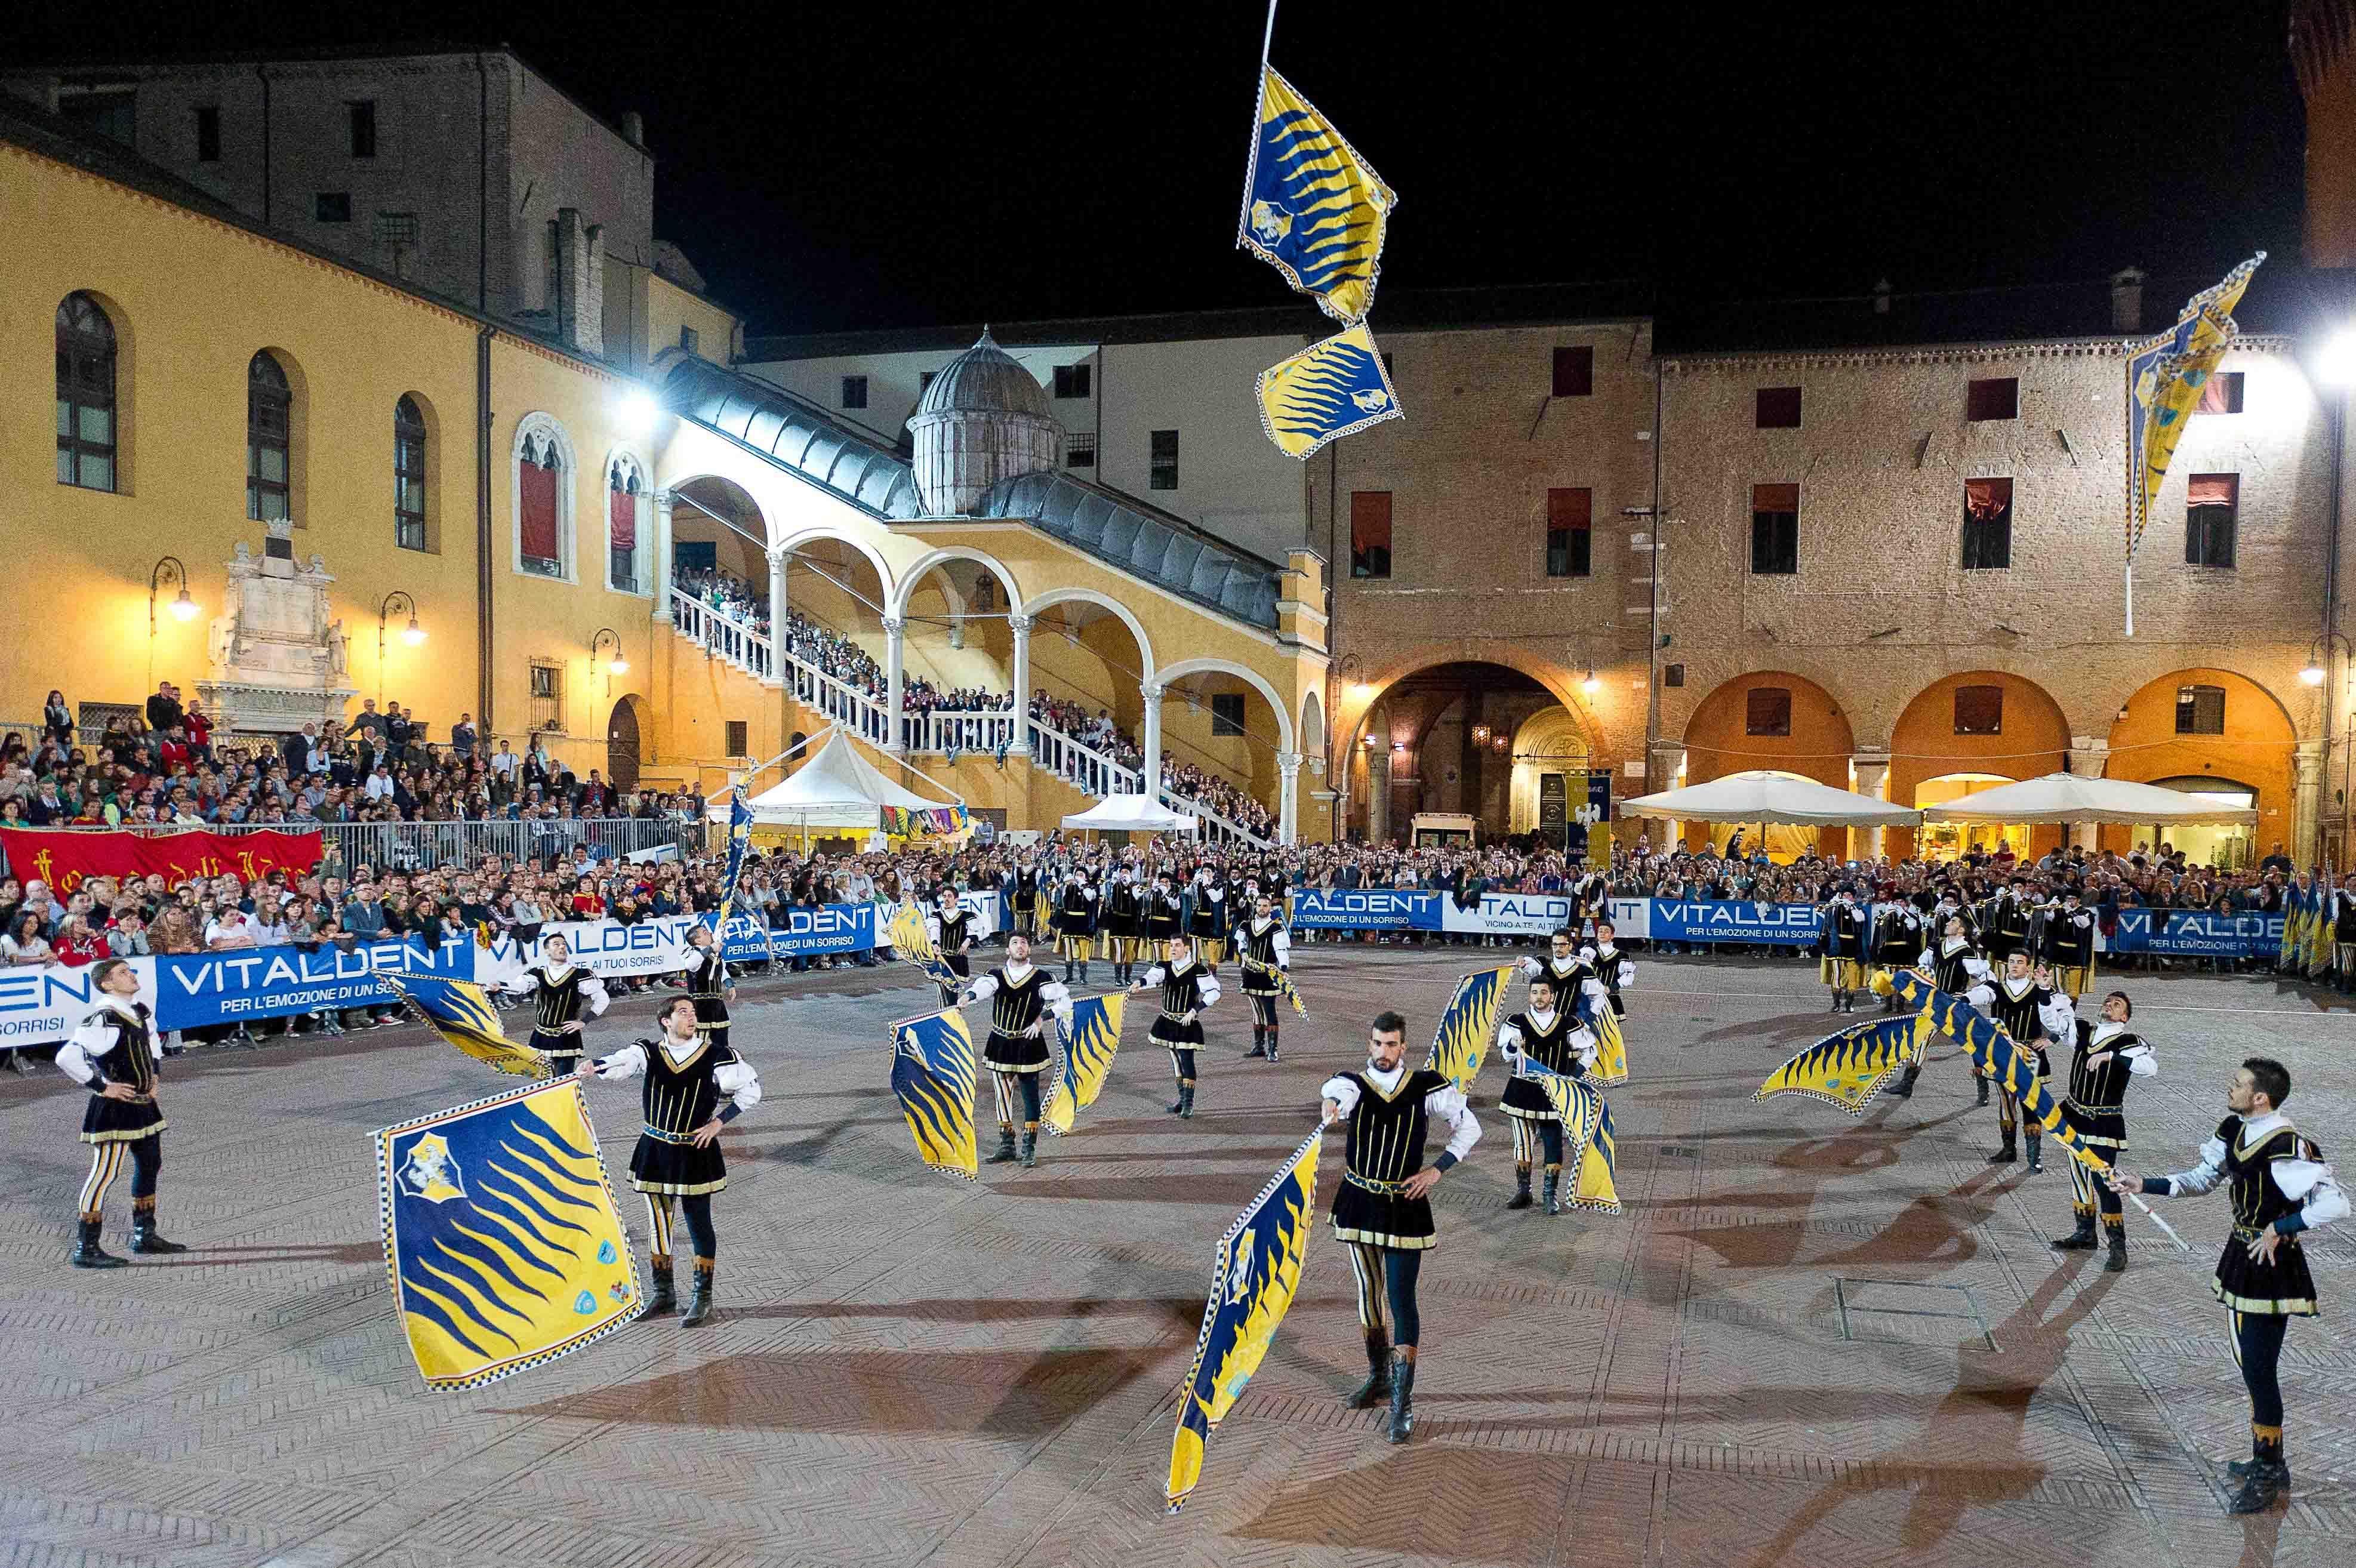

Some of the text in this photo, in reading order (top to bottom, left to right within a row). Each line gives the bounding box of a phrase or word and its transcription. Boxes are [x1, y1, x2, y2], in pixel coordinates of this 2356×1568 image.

[1299, 914, 1347, 923] L'EMOZIONE
[1373, 916, 1409, 925] SORRISO
[1485, 920, 1513, 928] VICINO
[1686, 927, 1704, 935] PER
[1707, 928, 1761, 937] L'EMOZIONE
[489, 922, 691, 962] VITLDENT
[727, 944, 744, 955] PER
[802, 938, 815, 948] UN
[817, 935, 854, 948] SORRISO
[2149, 939, 2169, 948] PER
[2173, 940, 2237, 950] L'EMOZIONE
[172, 939, 464, 995] VITALDENT
[592, 960, 601, 970] AI
[605, 958, 628, 969] TUOI
[630, 955, 664, 967] SORRISI
[0, 969, 138, 1012] EN
[221, 999, 252, 1013] PER
[255, 991, 337, 1011] L'EMOZIONE
[340, 987, 352, 1002] DI
[355, 984, 373, 998] UN
